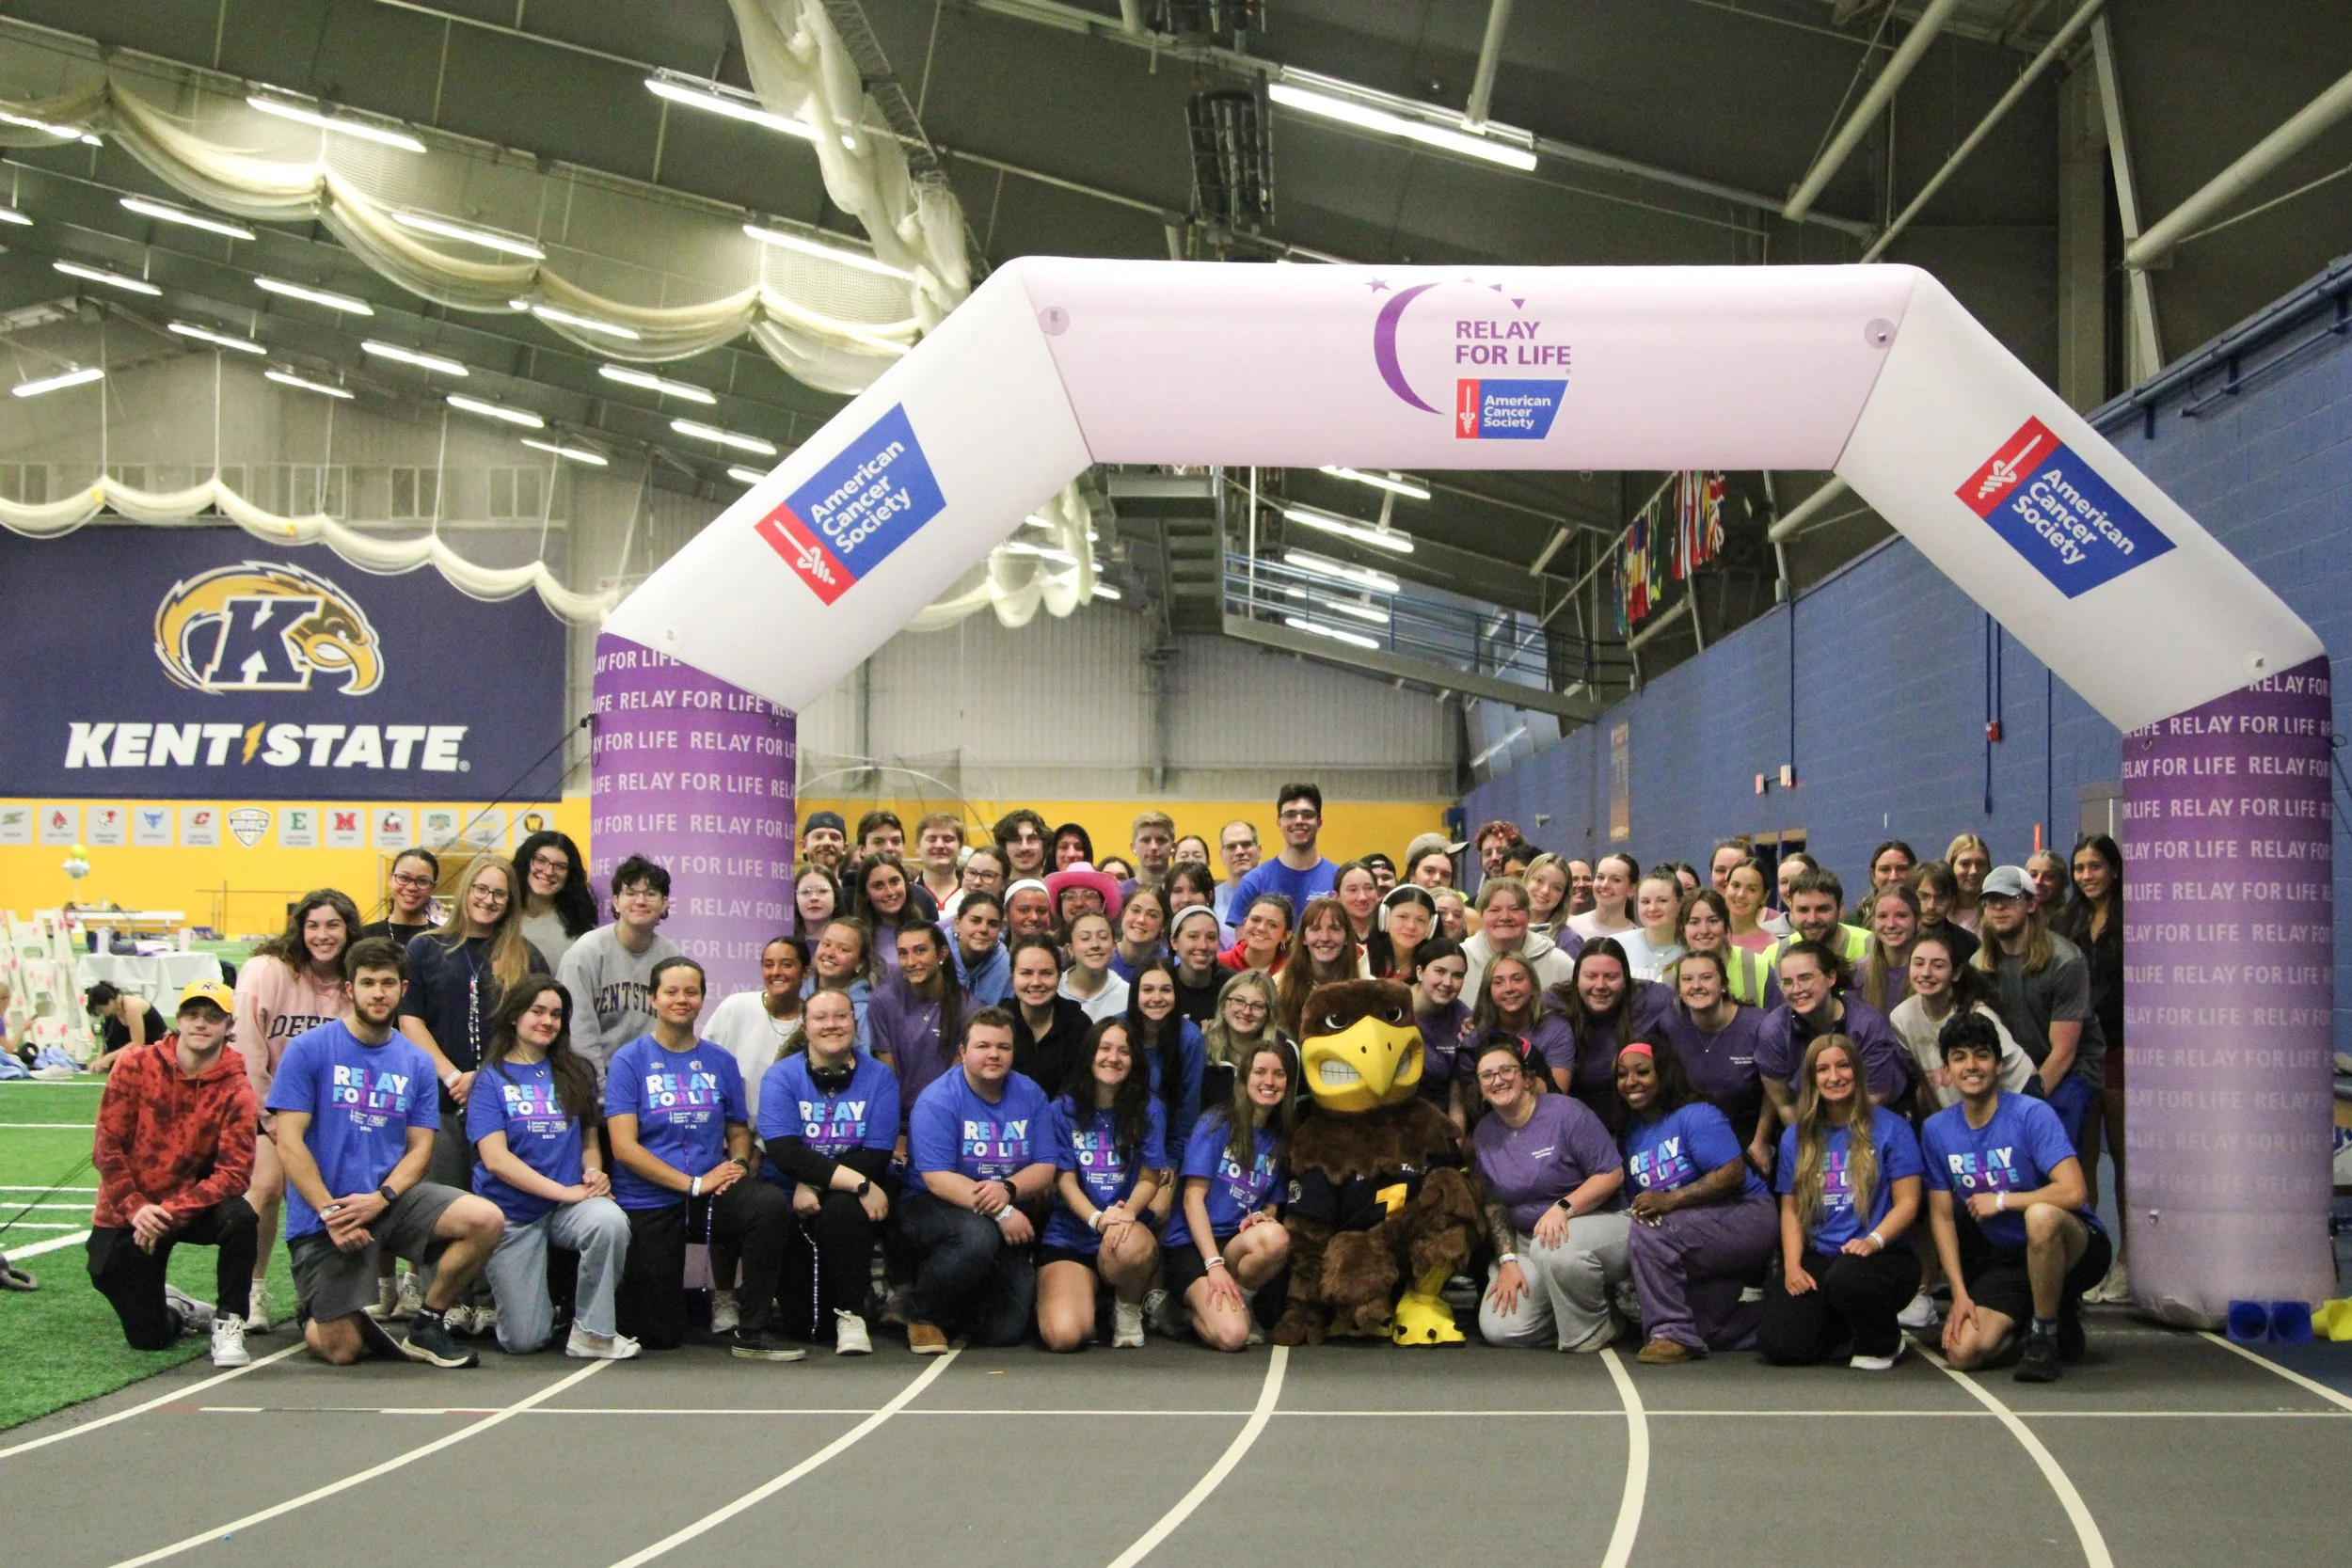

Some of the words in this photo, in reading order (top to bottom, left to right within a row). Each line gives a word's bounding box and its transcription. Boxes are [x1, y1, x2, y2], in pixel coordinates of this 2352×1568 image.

[1455, 321, 1540, 340] RELAY
[1455, 344, 1508, 365] FOR
[1518, 345, 1571, 365] LIFE
[1484, 395, 1551, 407] American
[1484, 406, 1532, 418] Cancer
[1484, 417, 1535, 430] Society
[810, 440, 905, 524] American
[822, 475, 892, 536] Cancer
[2029, 482, 2098, 545] Cancer
[2042, 468, 2135, 555] American
[835, 486, 912, 553] Society
[2011, 496, 2087, 564] Society
[610, 650, 637, 670] FOR
[2308, 677, 2328, 696] FOR
[620, 690, 676, 710] RELAY
[682, 690, 723, 709] FOR
[727, 693, 764, 713] LIFE
[2169, 716, 2233, 735] RELAY
[2240, 716, 2280, 734] FOR
[2284, 717, 2315, 736] LIFE
[64, 722, 242, 769] KENT
[260, 723, 469, 771] STATE
[605, 732, 633, 752] FOR
[639, 730, 678, 750] LIFE
[690, 731, 752, 752] RELAY
[755, 736, 784, 757] FOR
[2153, 758, 2187, 777] FOR
[2194, 756, 2236, 775] LIFE
[2249, 756, 2305, 774] RELAY
[618, 771, 675, 791] RELAY
[680, 772, 722, 792] FOR
[727, 773, 764, 795] LIFE
[2133, 800, 2161, 818] LIFE
[2170, 799, 2234, 816] RELAY
[2241, 799, 2280, 816] FOR
[2285, 800, 2316, 817] LIFE
[291, 812, 307, 831] E
[334, 813, 357, 831] M
[605, 814, 633, 833] FOR
[638, 813, 678, 832] LIFE
[690, 814, 751, 835] RELAY
[755, 818, 784, 839] FOR
[2154, 841, 2189, 859] FOR
[2195, 840, 2238, 858] LIFE
[2250, 840, 2306, 859] RELAY
[680, 855, 722, 876] FOR
[727, 858, 764, 878] LIFE
[2135, 883, 2163, 901] LIFE
[2171, 882, 2235, 900] RELAY
[2242, 882, 2281, 900] FOR
[2286, 883, 2317, 901] LIFE
[690, 897, 751, 918] RELAY
[755, 901, 783, 921] FOR
[2155, 924, 2191, 942] FOR
[2197, 924, 2240, 942] LIFE
[2252, 924, 2308, 942] RELAY
[681, 939, 722, 959] FOR
[727, 941, 762, 961] LIFE
[2136, 966, 2164, 984] LIFE
[2173, 966, 2236, 984] RELAY
[2243, 966, 2283, 984] FOR
[2288, 966, 2319, 985] LIFE
[2157, 1007, 2192, 1025] FOR
[2198, 1006, 2242, 1025] LIFE
[2254, 1007, 2309, 1025] RELAY
[2174, 1049, 2238, 1068] RELAY
[2245, 1050, 2284, 1068] FOR
[2289, 1051, 2320, 1069] LIFE
[334, 1065, 409, 1095] RELAY
[645, 1072, 717, 1095] RELAY
[333, 1086, 367, 1106] FOR
[368, 1091, 407, 1113] LIFE
[507, 1100, 545, 1117] FOR
[649, 1090, 686, 1109] FOR
[2158, 1090, 2194, 1108] FOR
[2200, 1090, 2243, 1109] LIFE
[2255, 1092, 2311, 1110] RELAY
[831, 1122, 866, 1138] LIFE
[963, 1119, 1027, 1141] RELAY
[962, 1141, 997, 1157] FOR
[998, 1140, 1030, 1157] LIFE
[2175, 1132, 2239, 1151] RELAY
[2247, 1133, 2286, 1151] FOR
[1629, 1136, 1679, 1176] RELAY
[1947, 1147, 2012, 1174] RELAY
[1656, 1155, 1689, 1181] LIFE
[1985, 1167, 2020, 1187] LIFE
